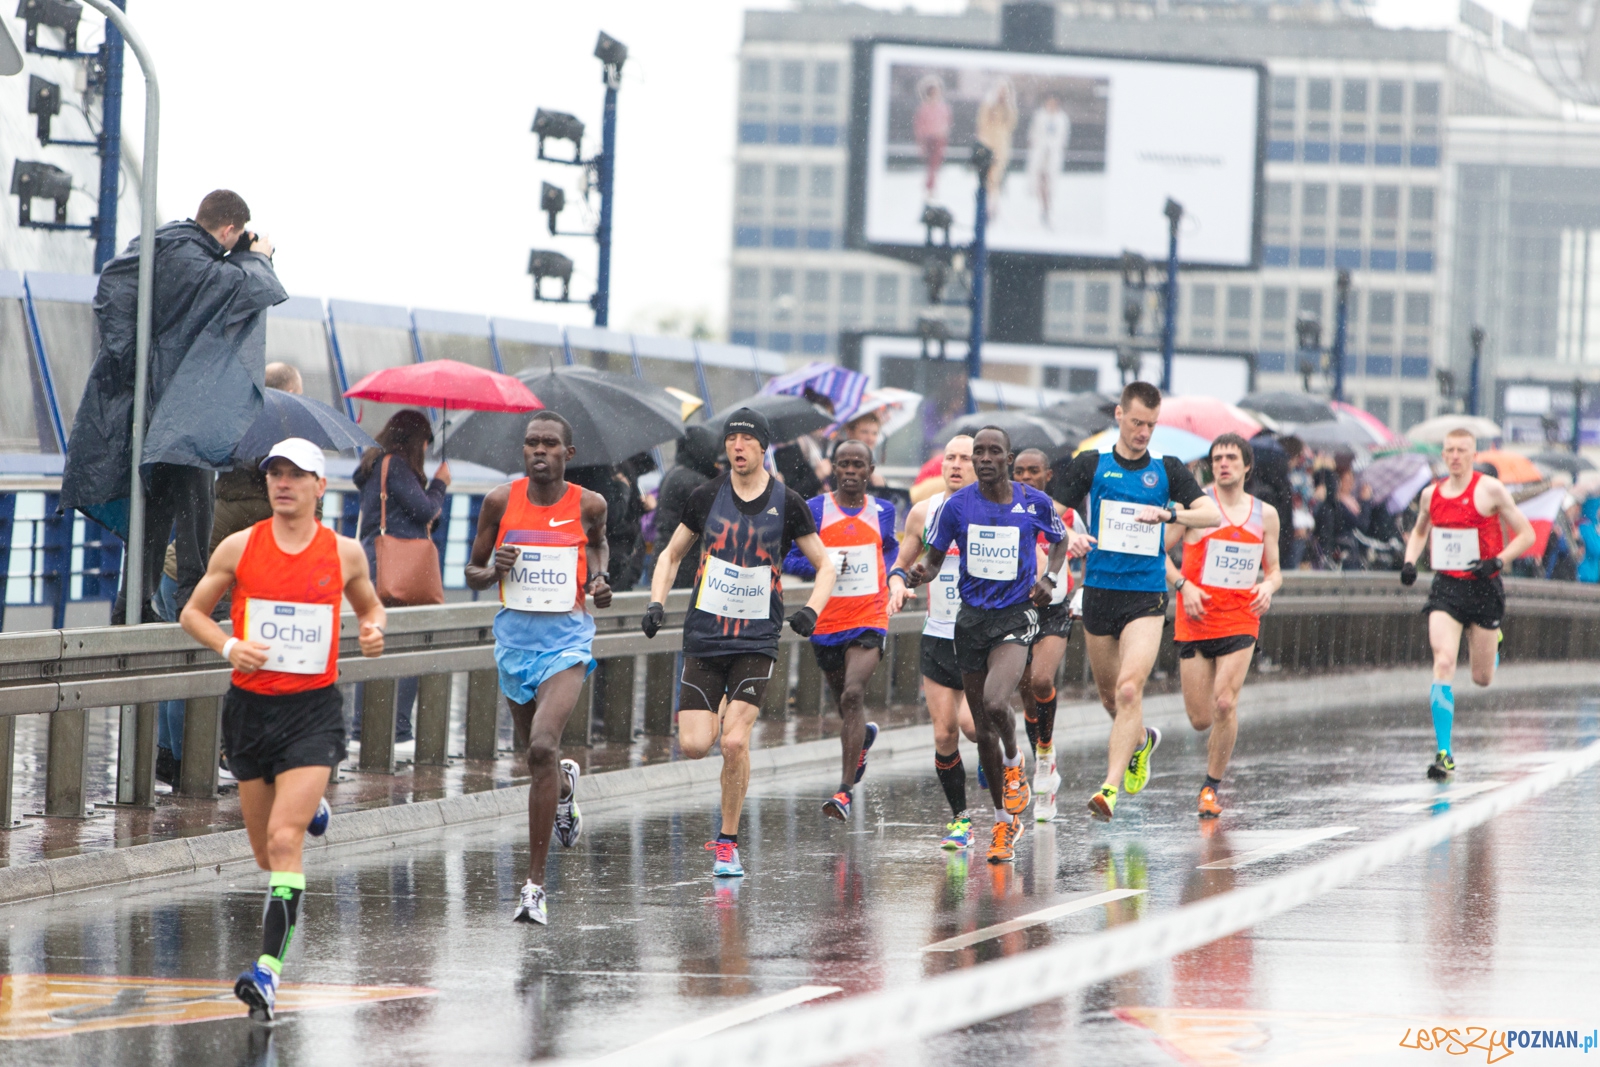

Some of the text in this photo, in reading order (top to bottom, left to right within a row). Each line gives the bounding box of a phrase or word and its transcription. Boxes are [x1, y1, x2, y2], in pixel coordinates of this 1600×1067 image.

[969, 542, 1017, 558] Biwot
[1216, 555, 1254, 571] 13296
[510, 567, 567, 585] Metto
[708, 576, 764, 597] Woźniak
[261, 622, 321, 642] Ochal
